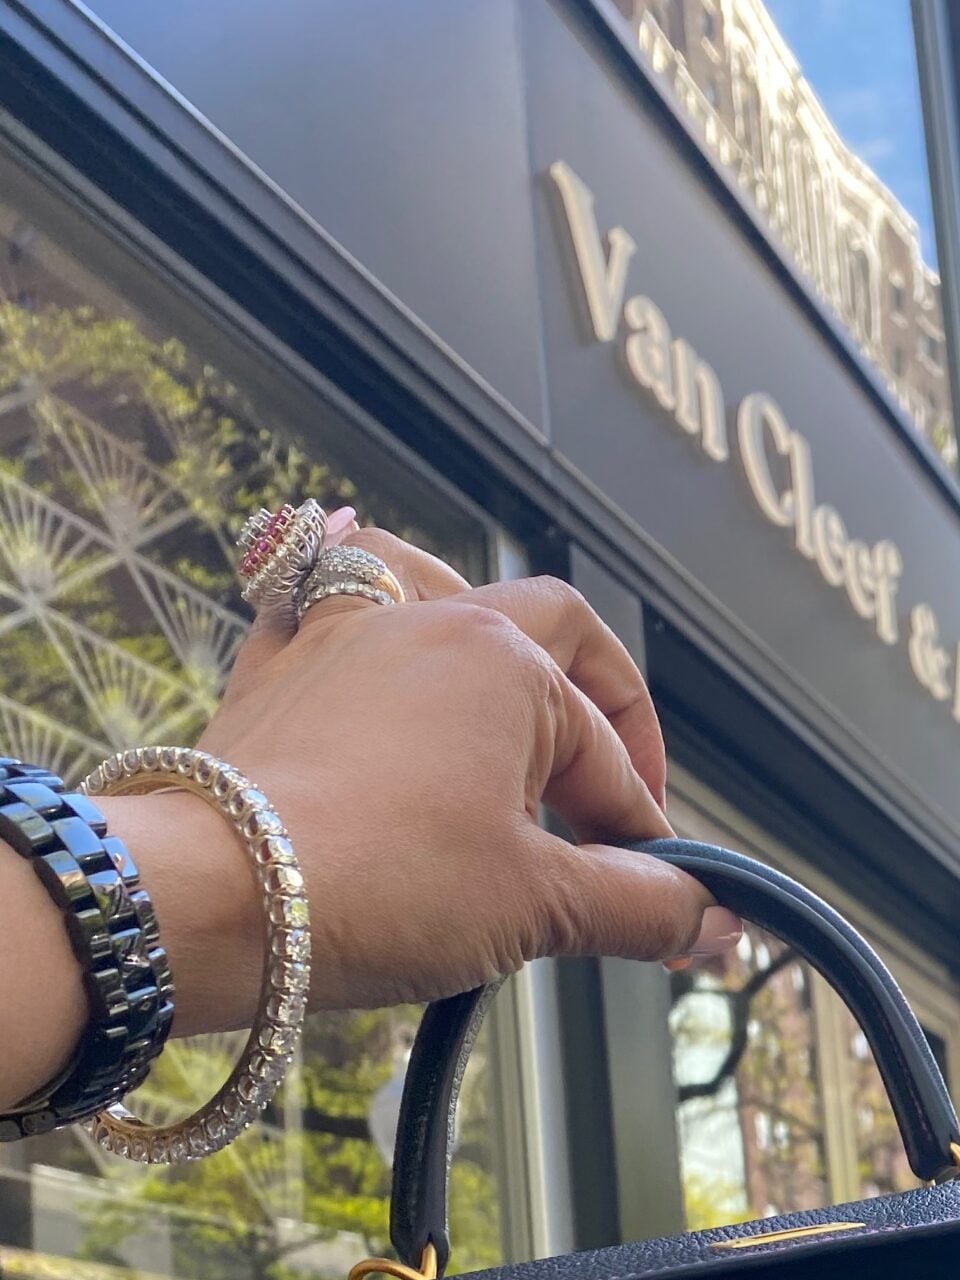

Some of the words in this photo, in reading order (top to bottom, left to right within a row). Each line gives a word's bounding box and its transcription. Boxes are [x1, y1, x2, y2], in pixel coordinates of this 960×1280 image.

[549, 160, 729, 462] Van
[736, 391, 903, 644] Cleef
[908, 603, 951, 701] &
